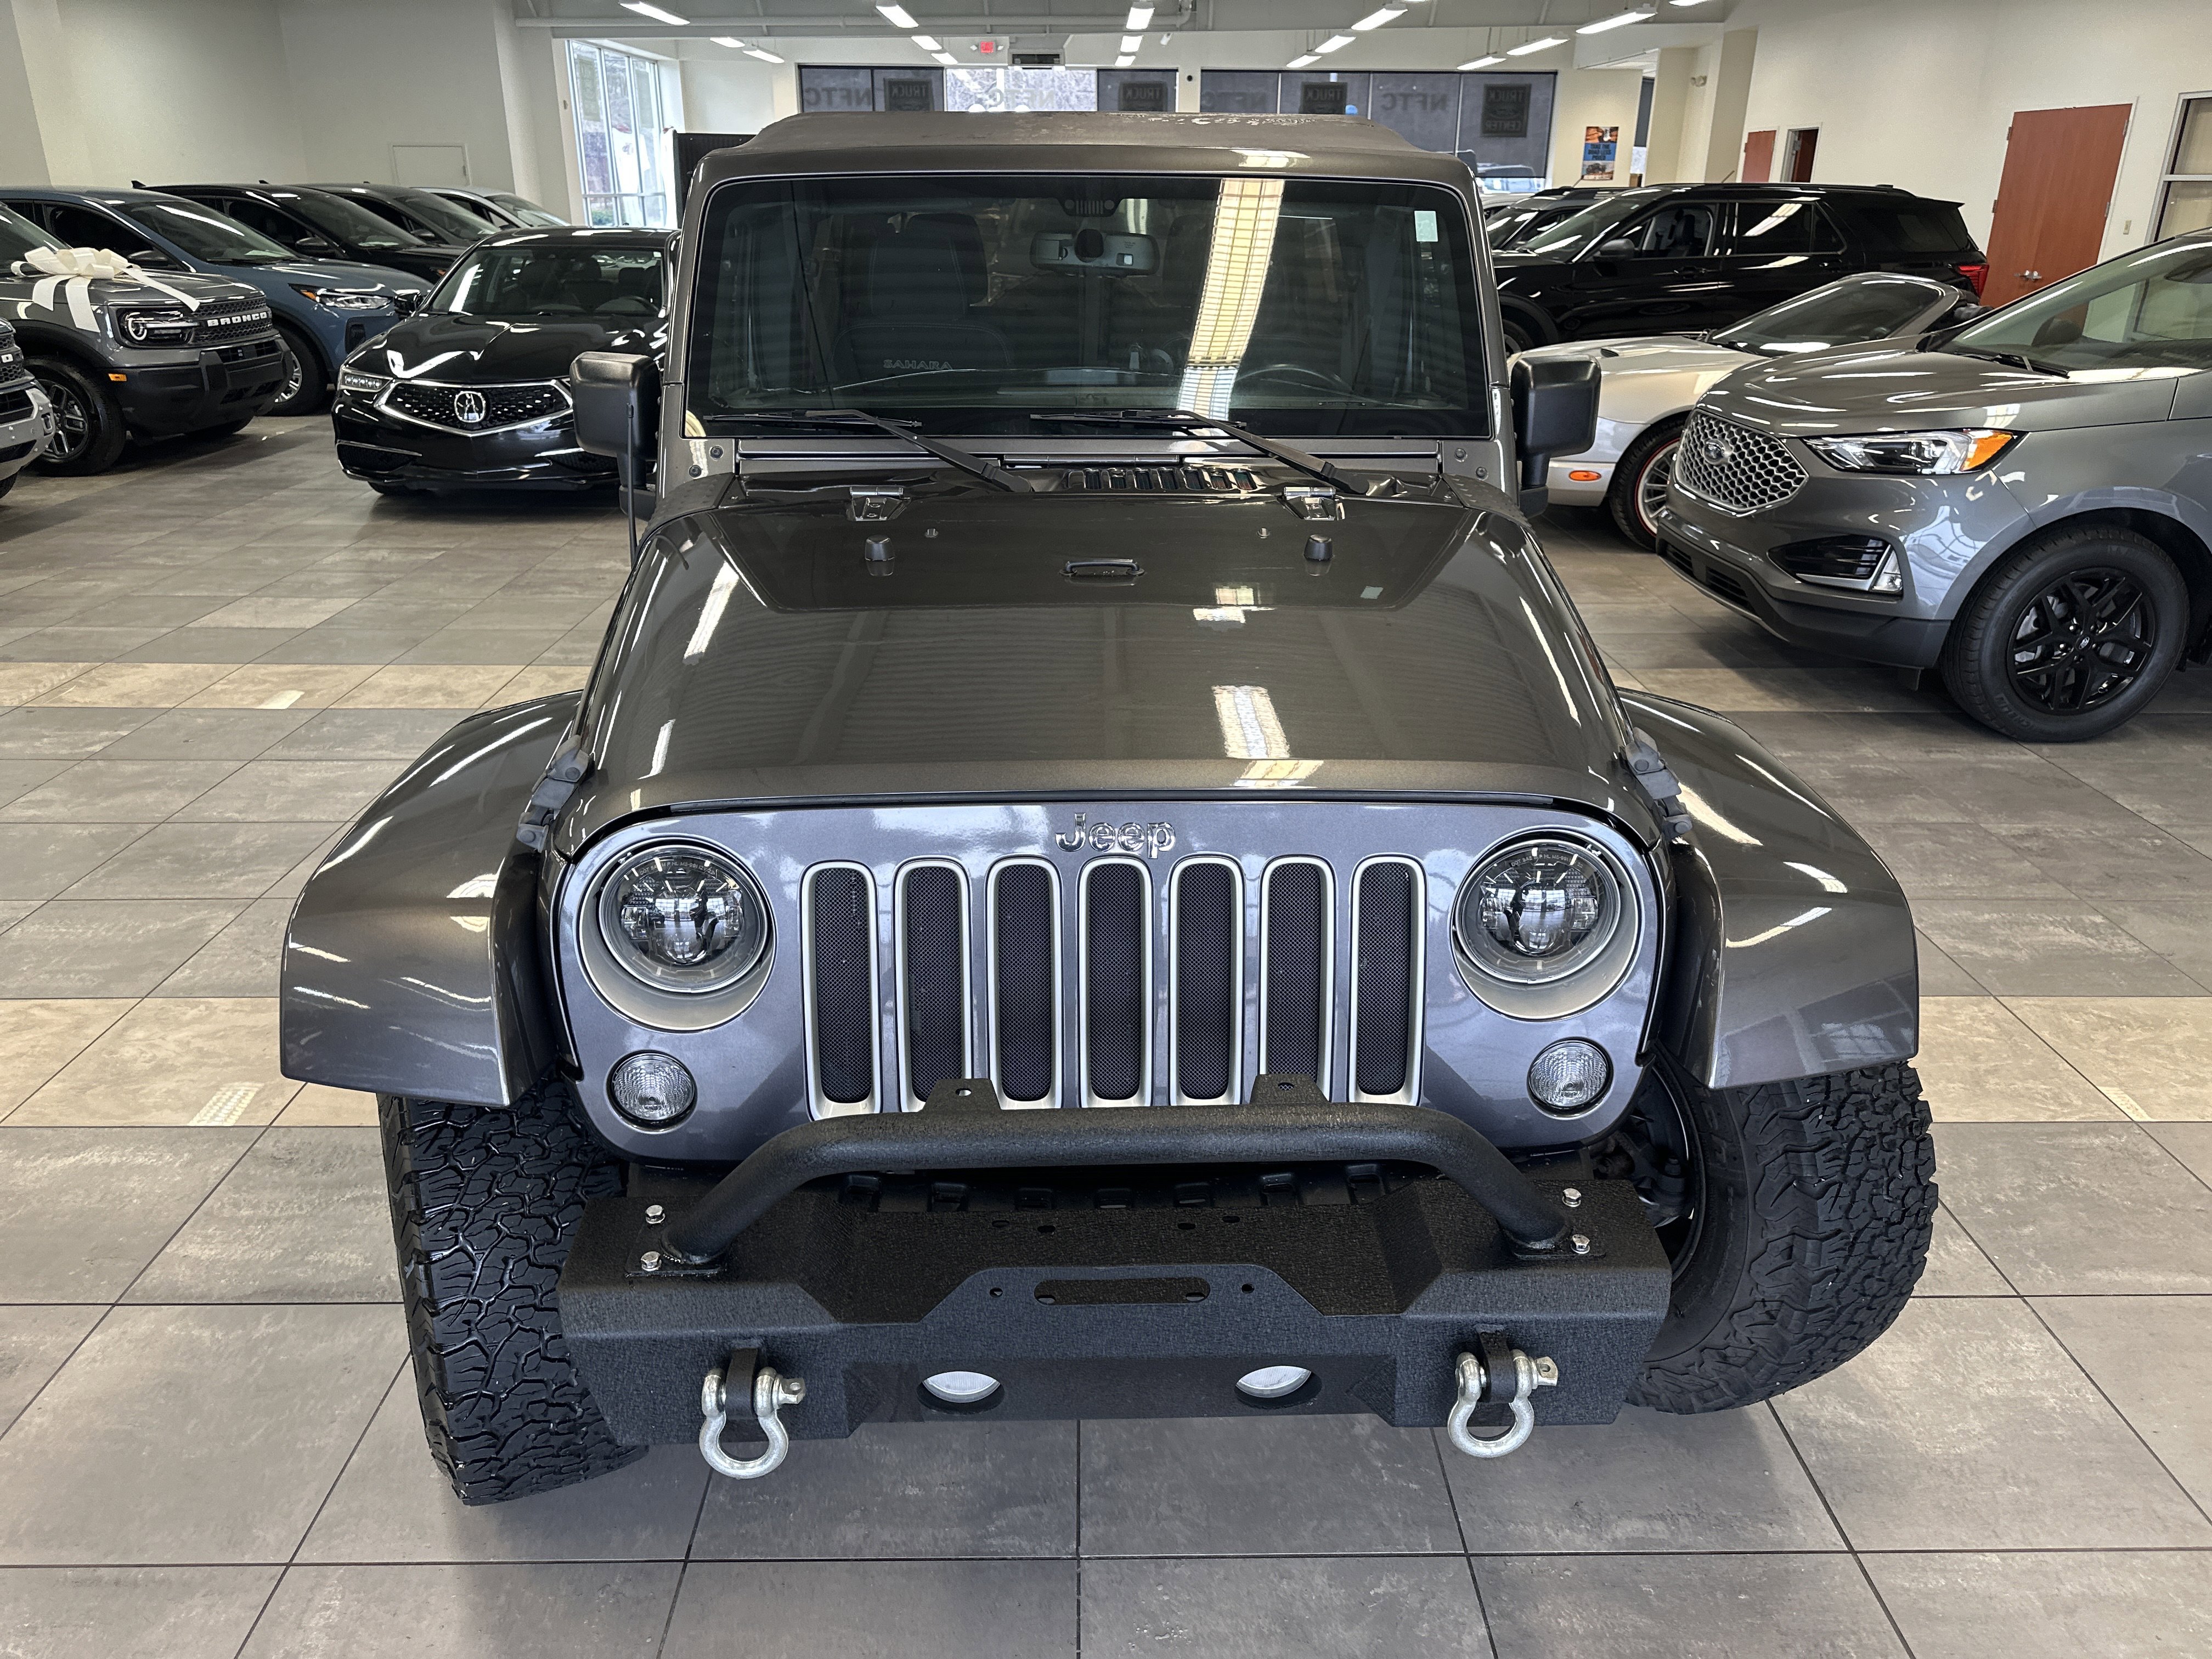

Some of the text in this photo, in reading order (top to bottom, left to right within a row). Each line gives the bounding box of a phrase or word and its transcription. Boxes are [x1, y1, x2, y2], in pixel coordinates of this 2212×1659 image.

[207, 312, 267, 326] BRONCO
[883, 359, 952, 370] SAHARA
[1056, 812, 1176, 859] Jeep
[640, 867, 649, 876] DOT
